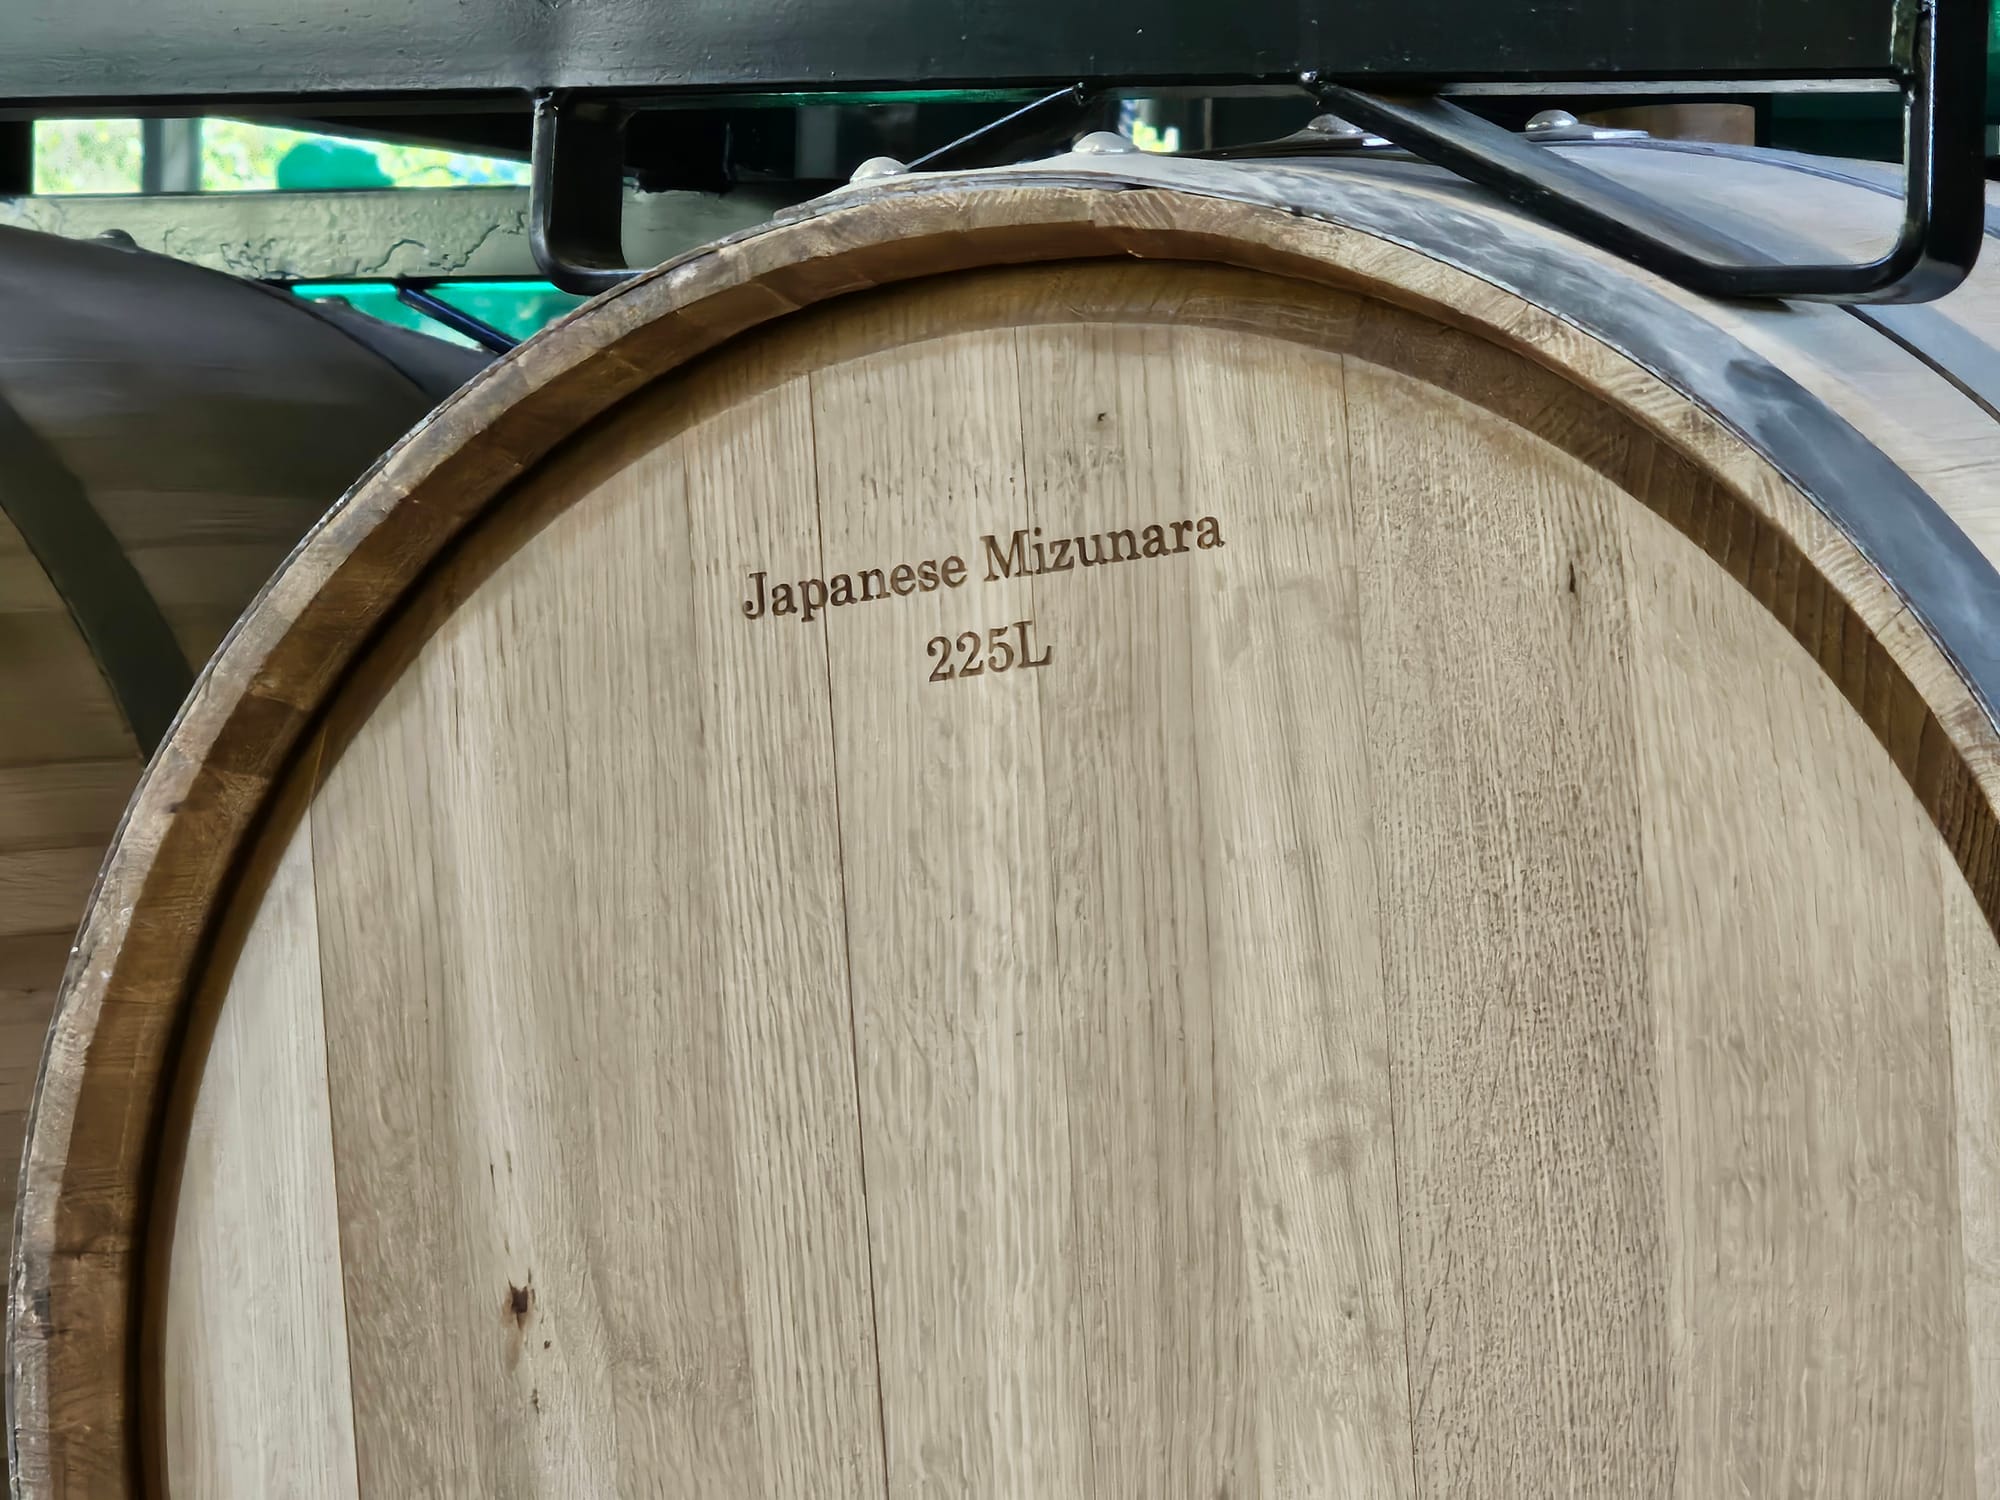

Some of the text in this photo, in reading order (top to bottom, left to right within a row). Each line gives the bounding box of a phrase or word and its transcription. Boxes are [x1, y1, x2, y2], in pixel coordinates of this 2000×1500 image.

[742, 515, 1225, 622] Japanese Mizunara
[926, 620, 1052, 682] 225L
